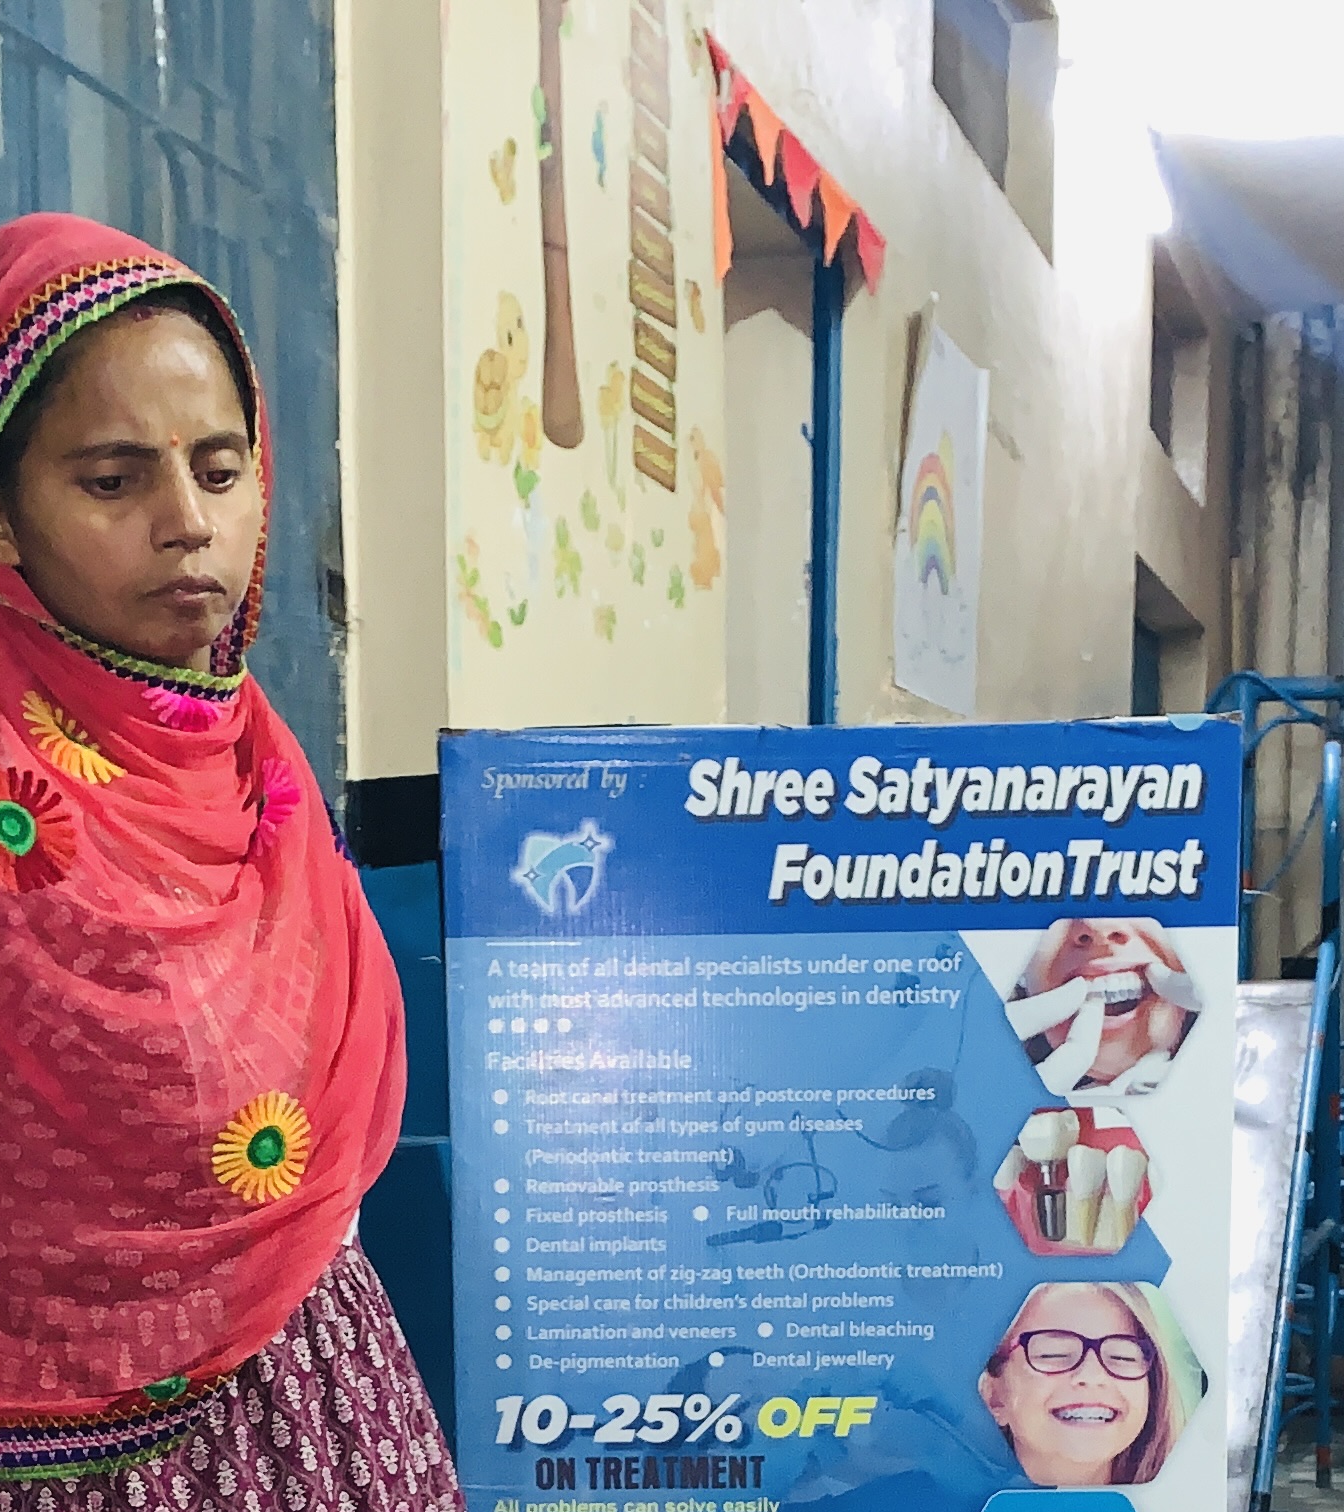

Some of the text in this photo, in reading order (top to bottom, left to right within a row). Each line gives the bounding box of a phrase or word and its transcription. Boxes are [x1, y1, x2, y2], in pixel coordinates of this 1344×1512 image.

[481, 766, 590, 799] Sponsored
[601, 765, 629, 798] by
[684, 756, 1204, 823] Shree Satyanarayan
[487, 951, 964, 980] A team of all dental specialists under one roof
[488, 984, 961, 1012] with most advanced technologies in dentistry
[485, 1049, 693, 1071] Facilities Available
[525, 1084, 936, 1106] Root canal treatment and postcore procedures
[526, 1115, 864, 1137] Treatment of all types of gum diseases
[525, 1148, 735, 1168] (Periodontic treatment)
[525, 1177, 721, 1196] Removable prosthesis
[526, 1206, 668, 1227] Fixed prosthesis
[726, 1204, 945, 1222] Full mouth rehabilitation
[526, 1237, 668, 1257] Dental implants
[526, 1261, 1003, 1286] Management of zig-zag teeth (Orthodontic treatment)
[526, 1292, 895, 1316] Special care for children's dental problems
[527, 1323, 738, 1341] Lamination and veneers
[786, 1320, 935, 1341] Dental bleaching
[529, 1352, 680, 1374] De-pigmentation
[752, 1350, 895, 1371] Dental jewellery
[494, 1393, 879, 1446] 10-25% OFF
[535, 1455, 766, 1491] ON TREATMENT
